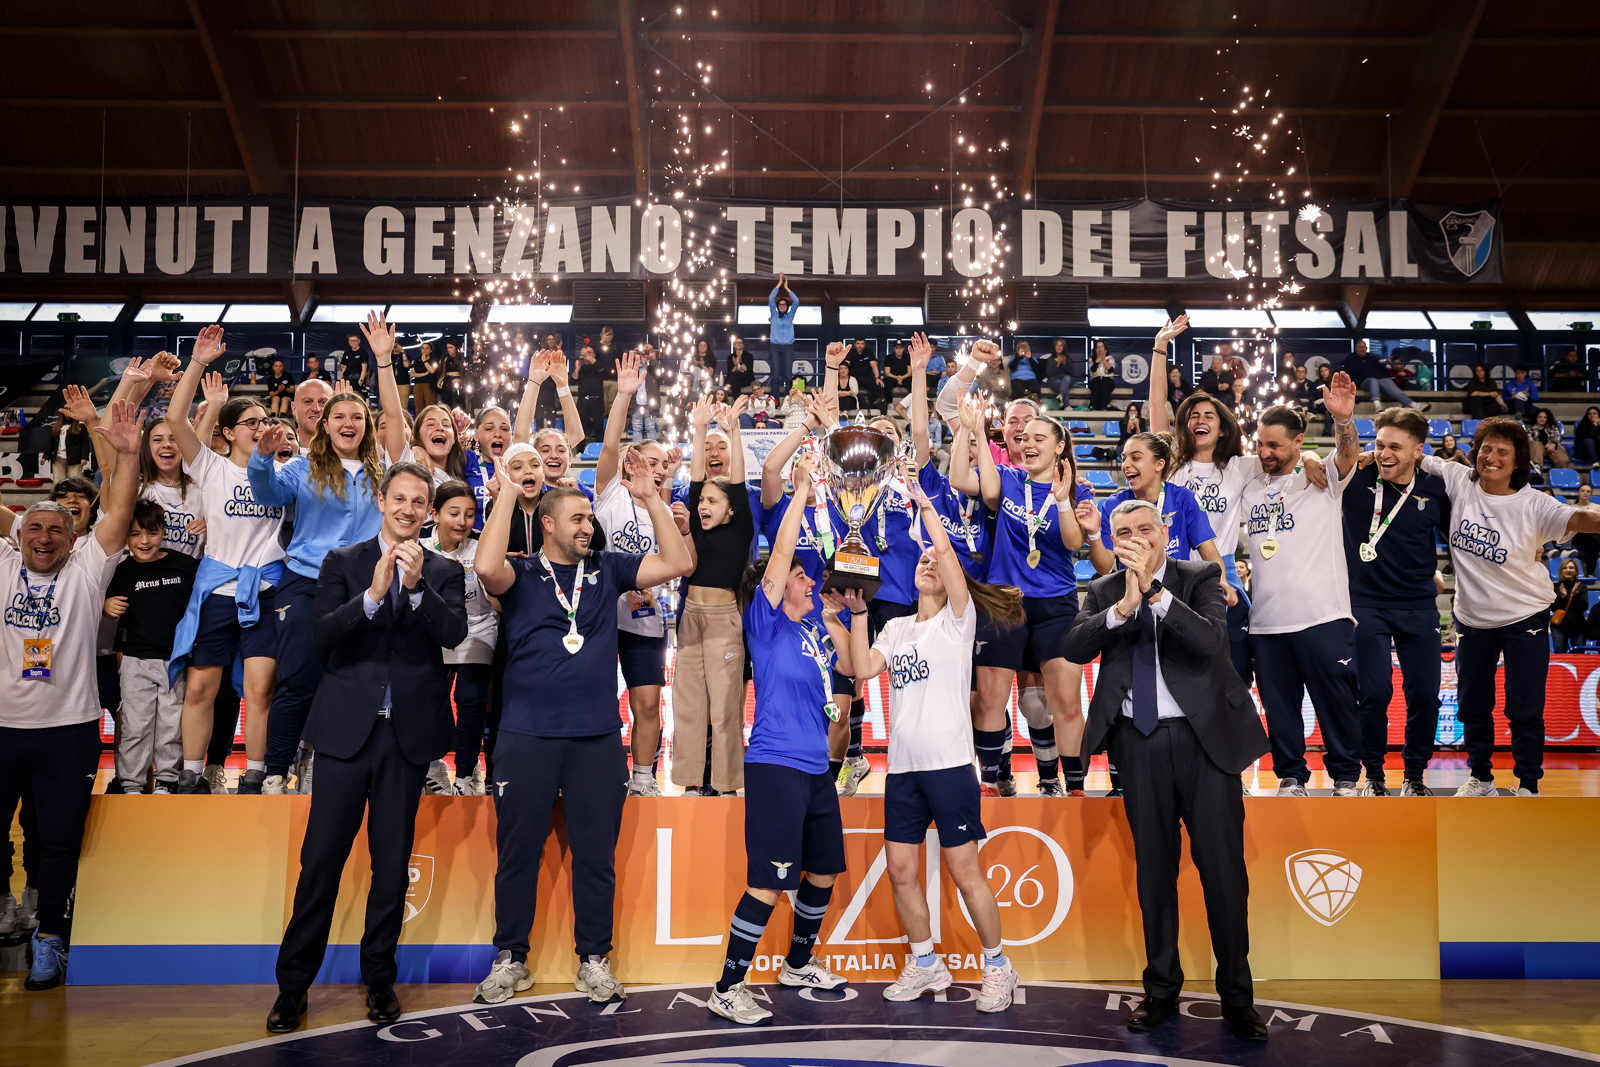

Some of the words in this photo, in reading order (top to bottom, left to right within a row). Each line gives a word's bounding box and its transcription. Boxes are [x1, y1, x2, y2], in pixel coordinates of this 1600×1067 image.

[0, 205, 269, 275] VENUTI
[294, 206, 338, 275] A
[363, 205, 682, 275] GENZANO
[727, 207, 993, 277] TEMPIO
[1021, 209, 1141, 278] DEL
[1167, 210, 1418, 280] FUTSAL
[225, 500, 266, 517] CALCIO
[163, 511, 195, 529] AZIO
[1451, 531, 1485, 557] CALCIO
[1459, 519, 1501, 547] LAZIO
[846, 555, 868, 565] LAZIO
[135, 579, 160, 591] Mens
[162, 576, 182, 586] brand
[655, 826, 1074, 946] LZIO
[986, 863, 1045, 908] 26
[826, 953, 897, 971] ITALIA
